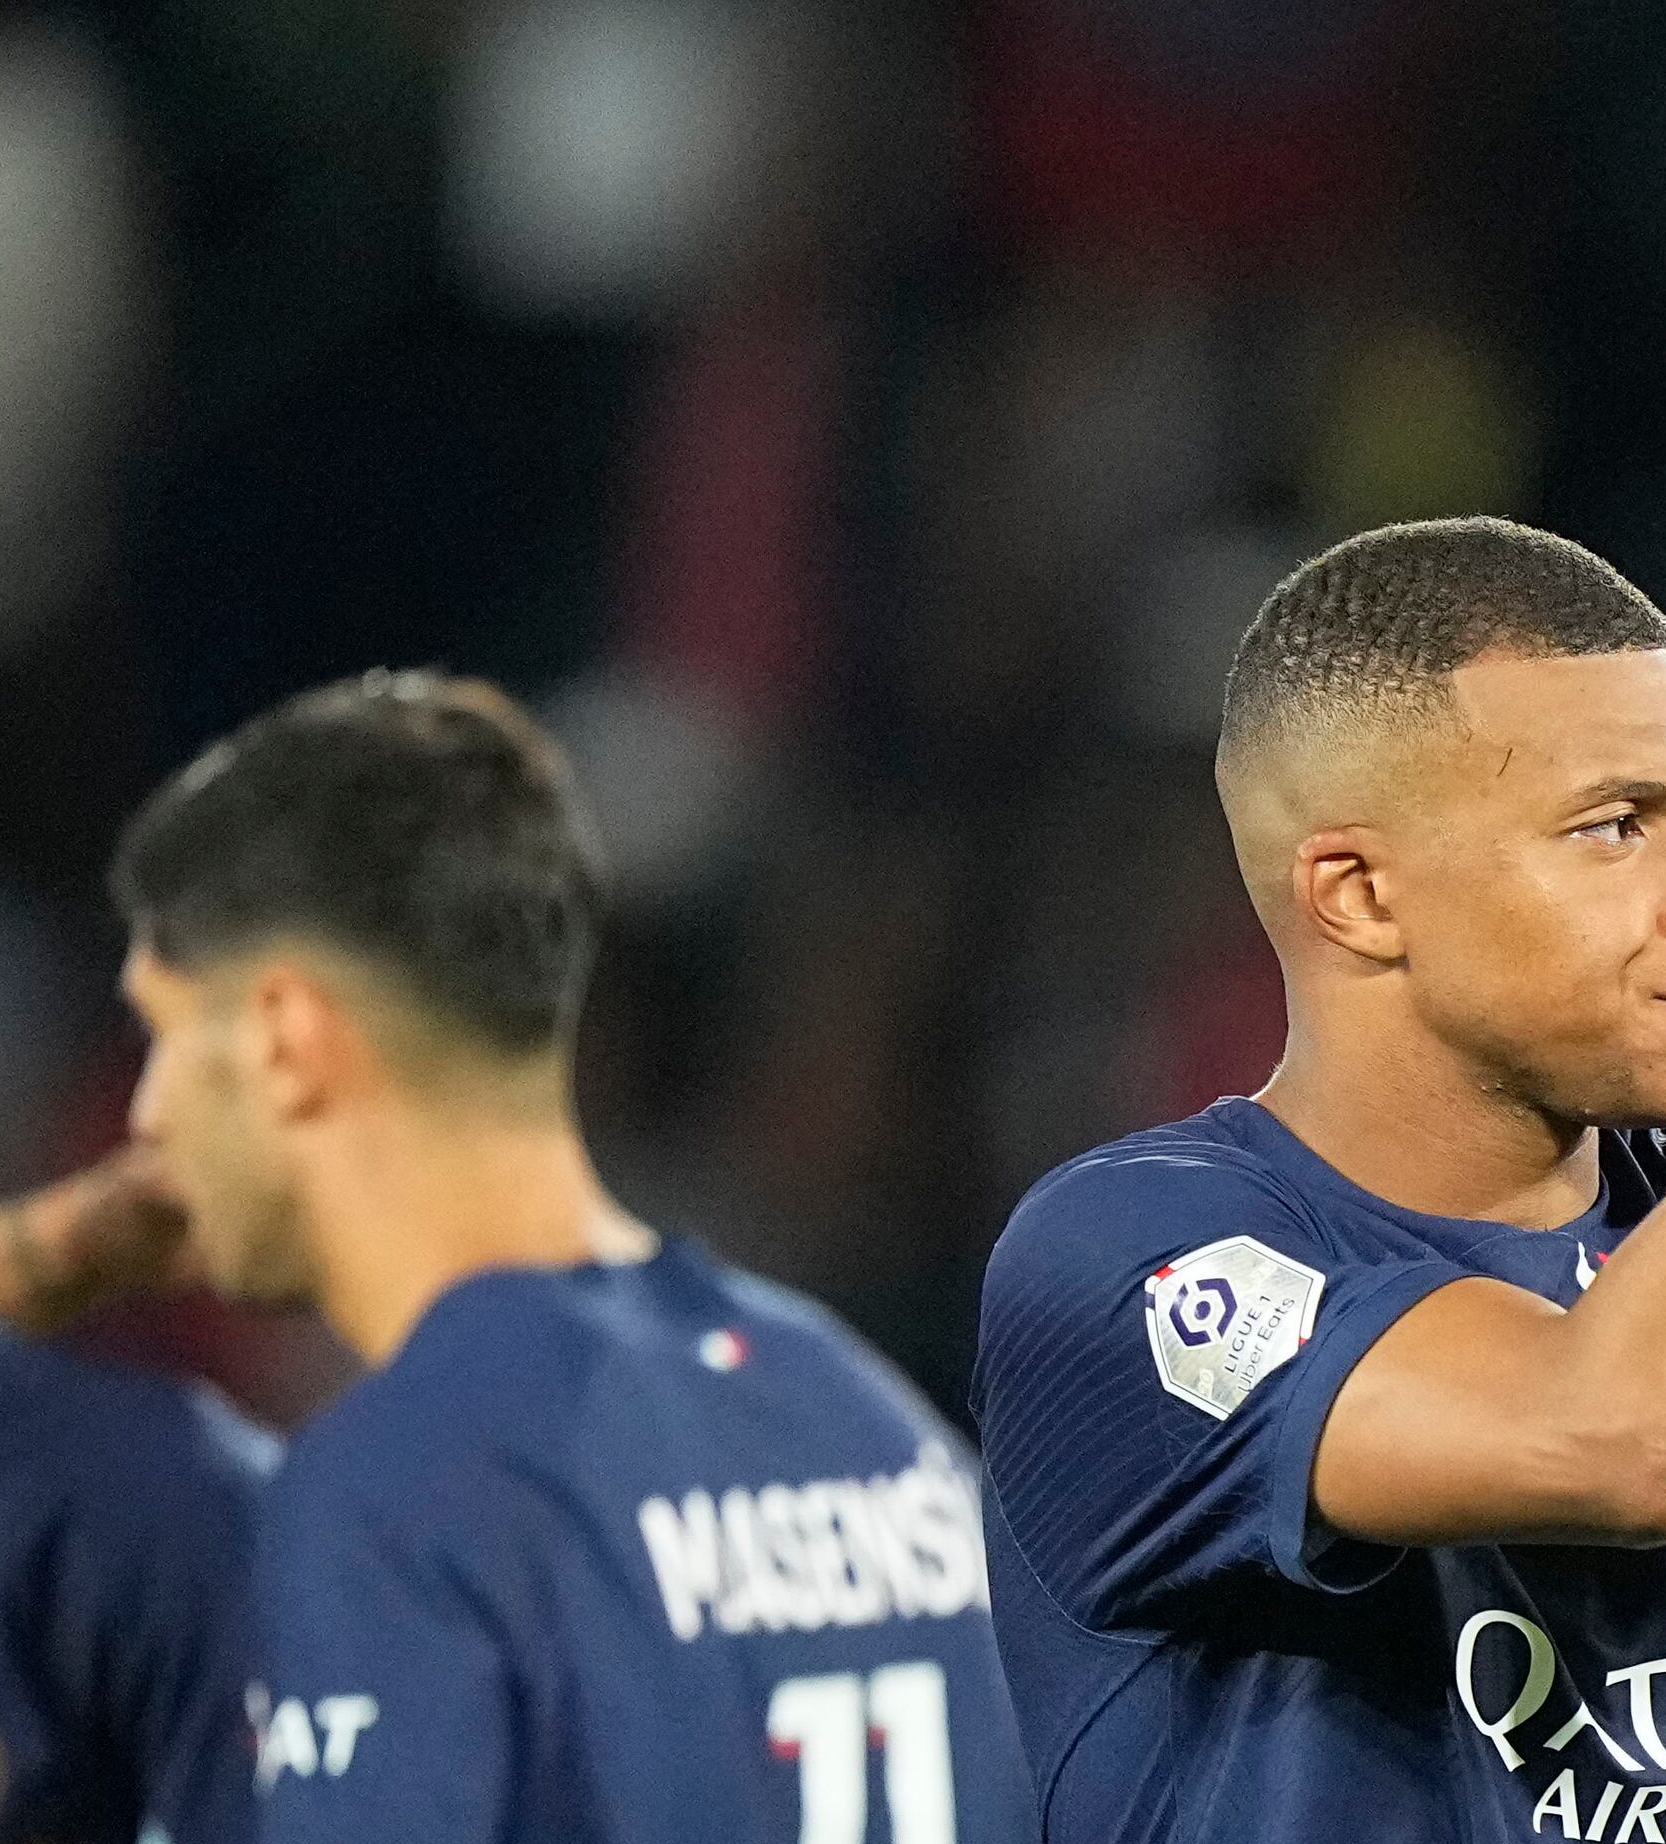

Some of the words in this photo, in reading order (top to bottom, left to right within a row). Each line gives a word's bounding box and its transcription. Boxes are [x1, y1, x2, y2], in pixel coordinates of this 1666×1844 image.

[1224, 1308, 1262, 1373] LIGUE
[1237, 1344, 1263, 1392] Uber
[1257, 1298, 1295, 1341] Eats
[245, 1682, 381, 1792] AT
